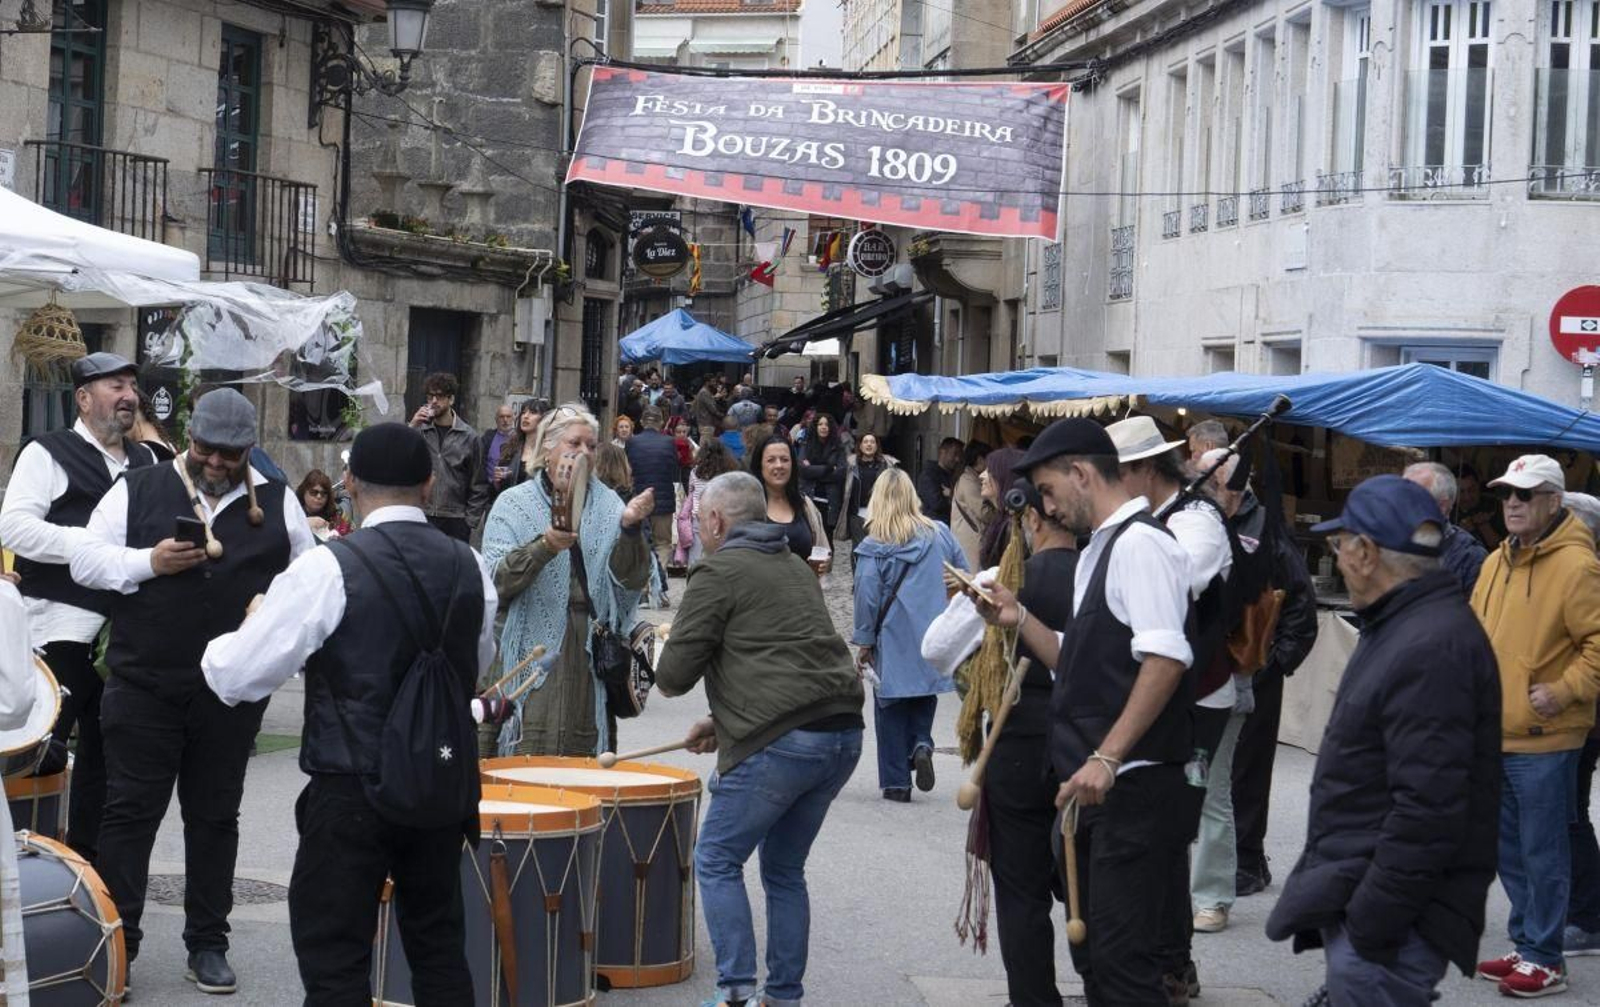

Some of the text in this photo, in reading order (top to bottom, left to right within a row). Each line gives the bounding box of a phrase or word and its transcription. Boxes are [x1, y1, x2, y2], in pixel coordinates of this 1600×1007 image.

[629, 95, 1014, 143] FESTA DA BRINCADEIRA
[669, 119, 958, 185] BOUZAS 1809
